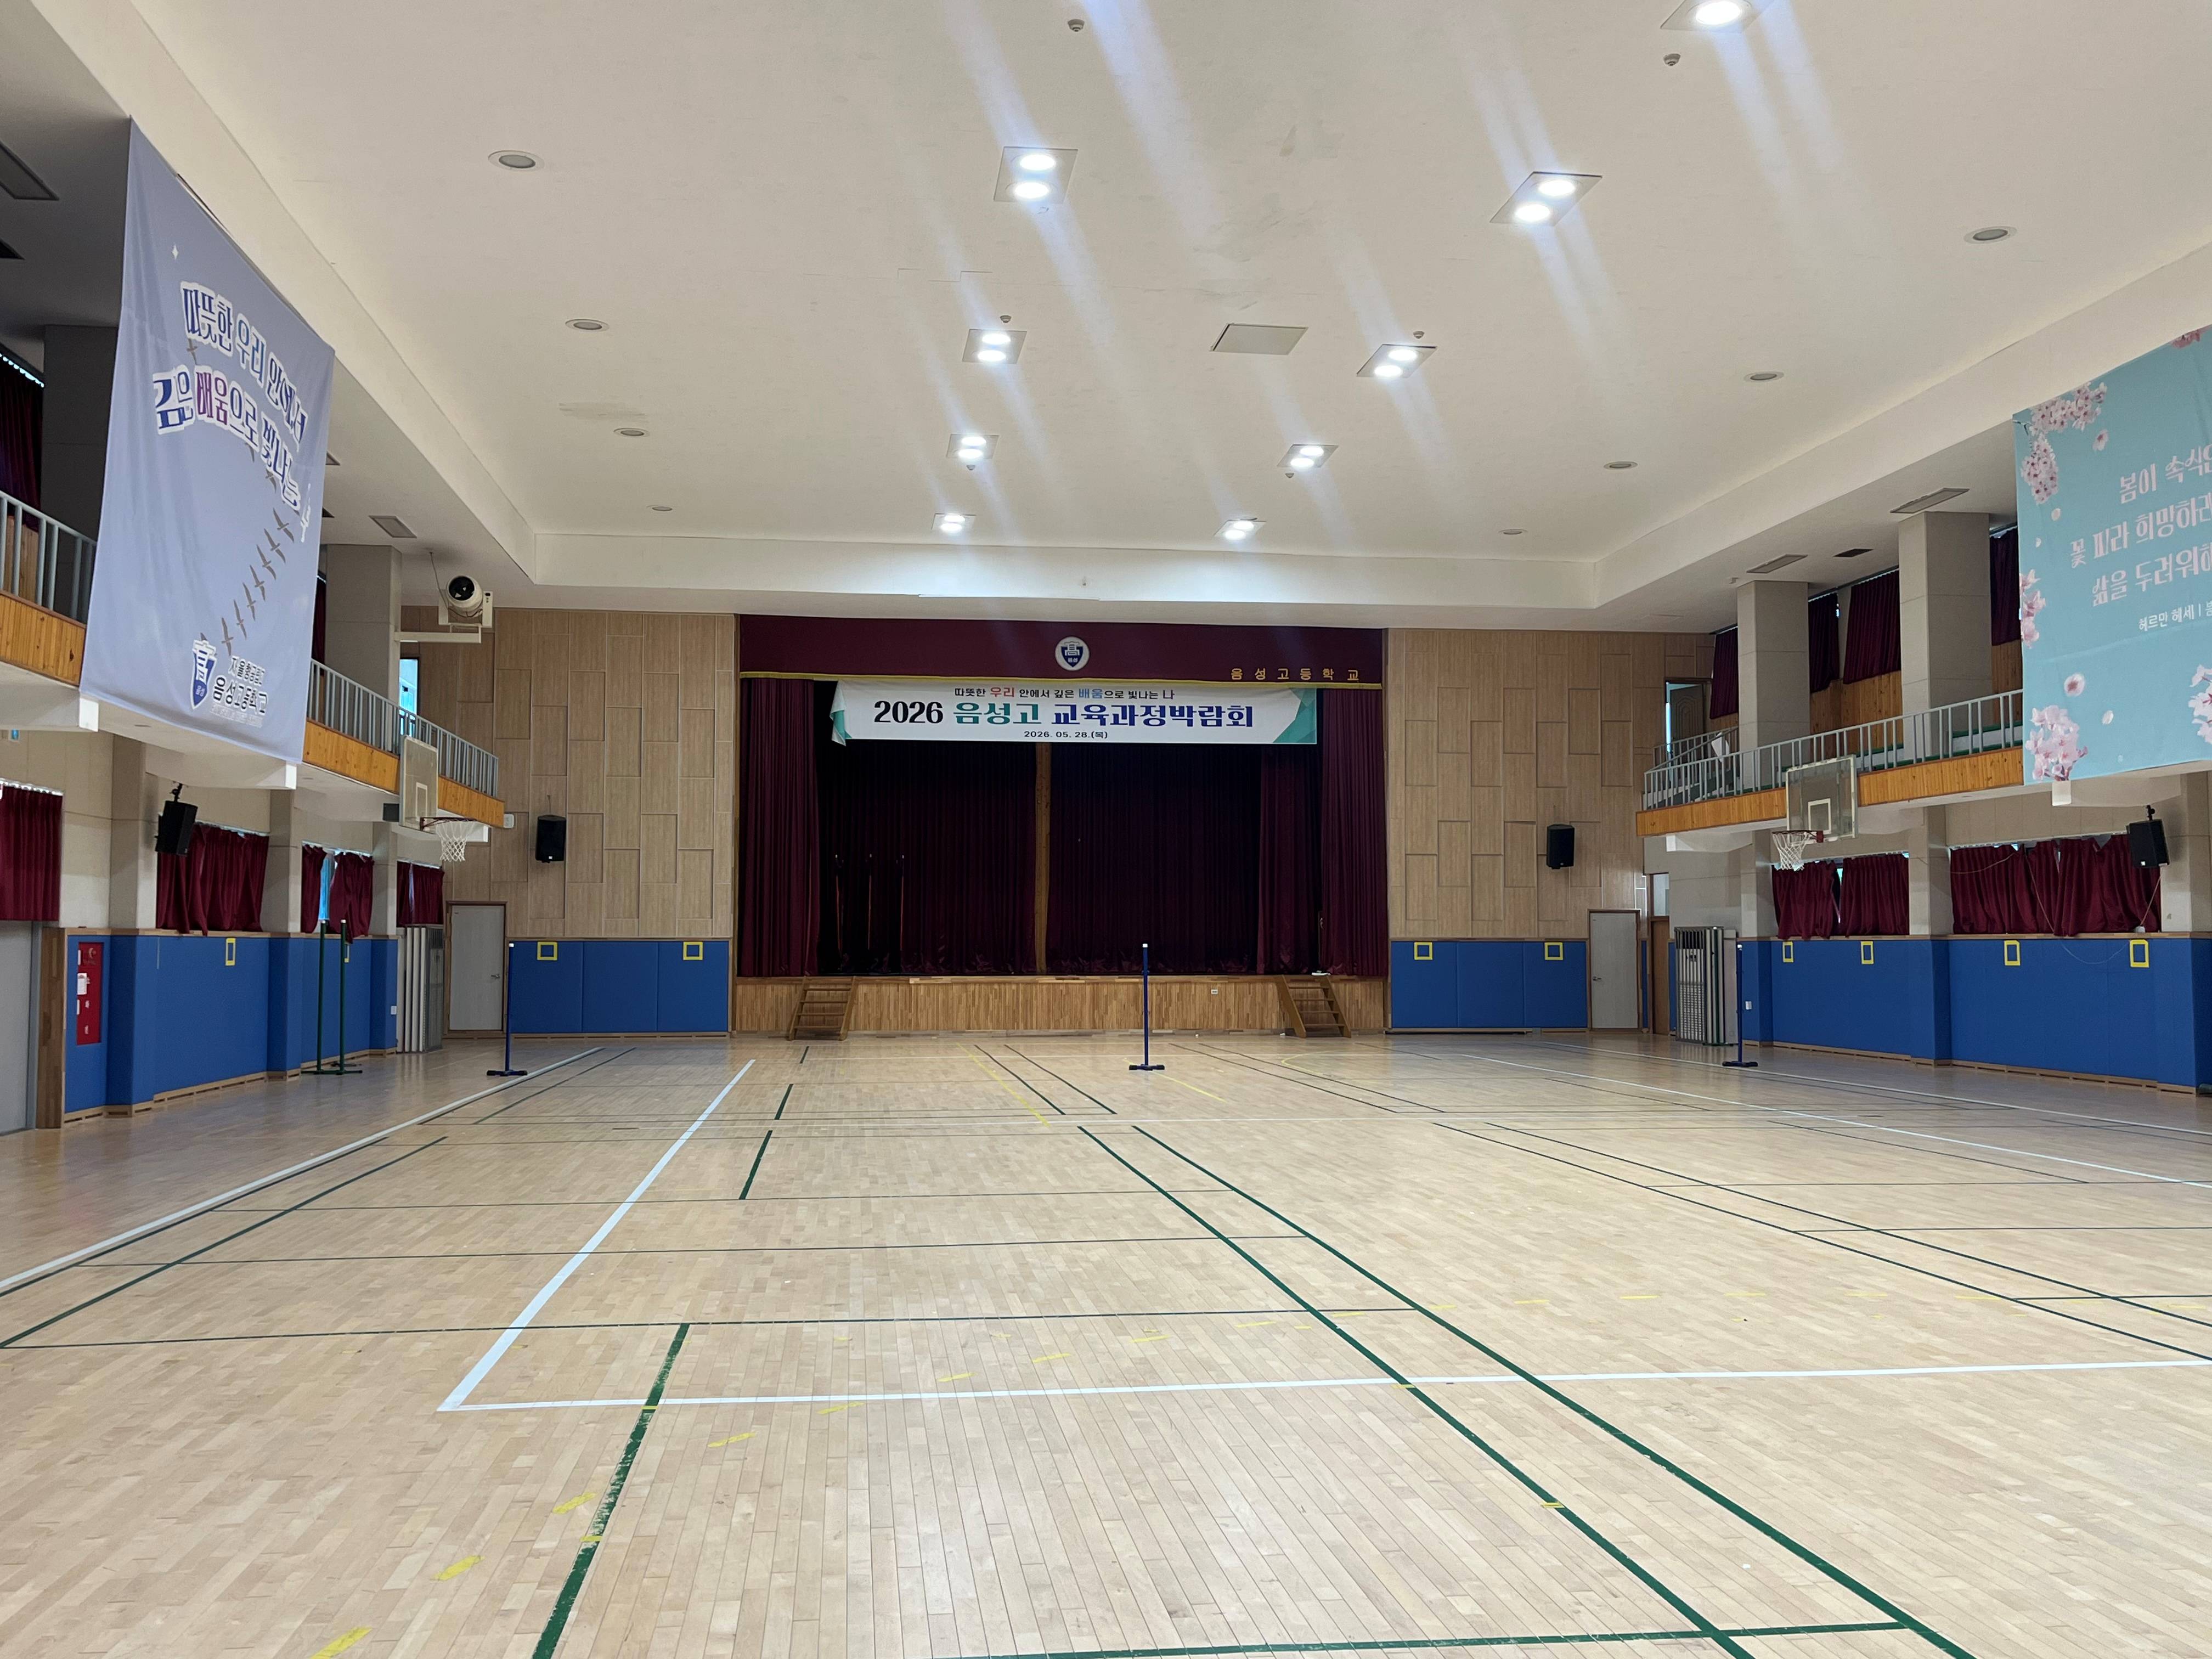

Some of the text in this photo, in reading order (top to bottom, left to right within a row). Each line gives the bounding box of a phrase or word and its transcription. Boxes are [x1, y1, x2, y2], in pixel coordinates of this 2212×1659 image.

[182, 286, 307, 445] 따뜻한 우리 안에서
[153, 370, 299, 507] 깊은 배움으로 빛나는
[2120, 463, 2157, 504] 봄이
[2070, 538, 2086, 568] 꽃
[2093, 521, 2130, 559] 피라
[2092, 569, 2128, 607] 삶을
[955, 687, 1175, 700] 따뜻한 우리 안에서 깊은 배움으로 빛나는 나
[1231, 668, 1359, 681] 음성고등학교
[213, 676, 267, 714] 음성고등학교
[874, 700, 1253, 727] 2026 음성고 교육과정박람회
